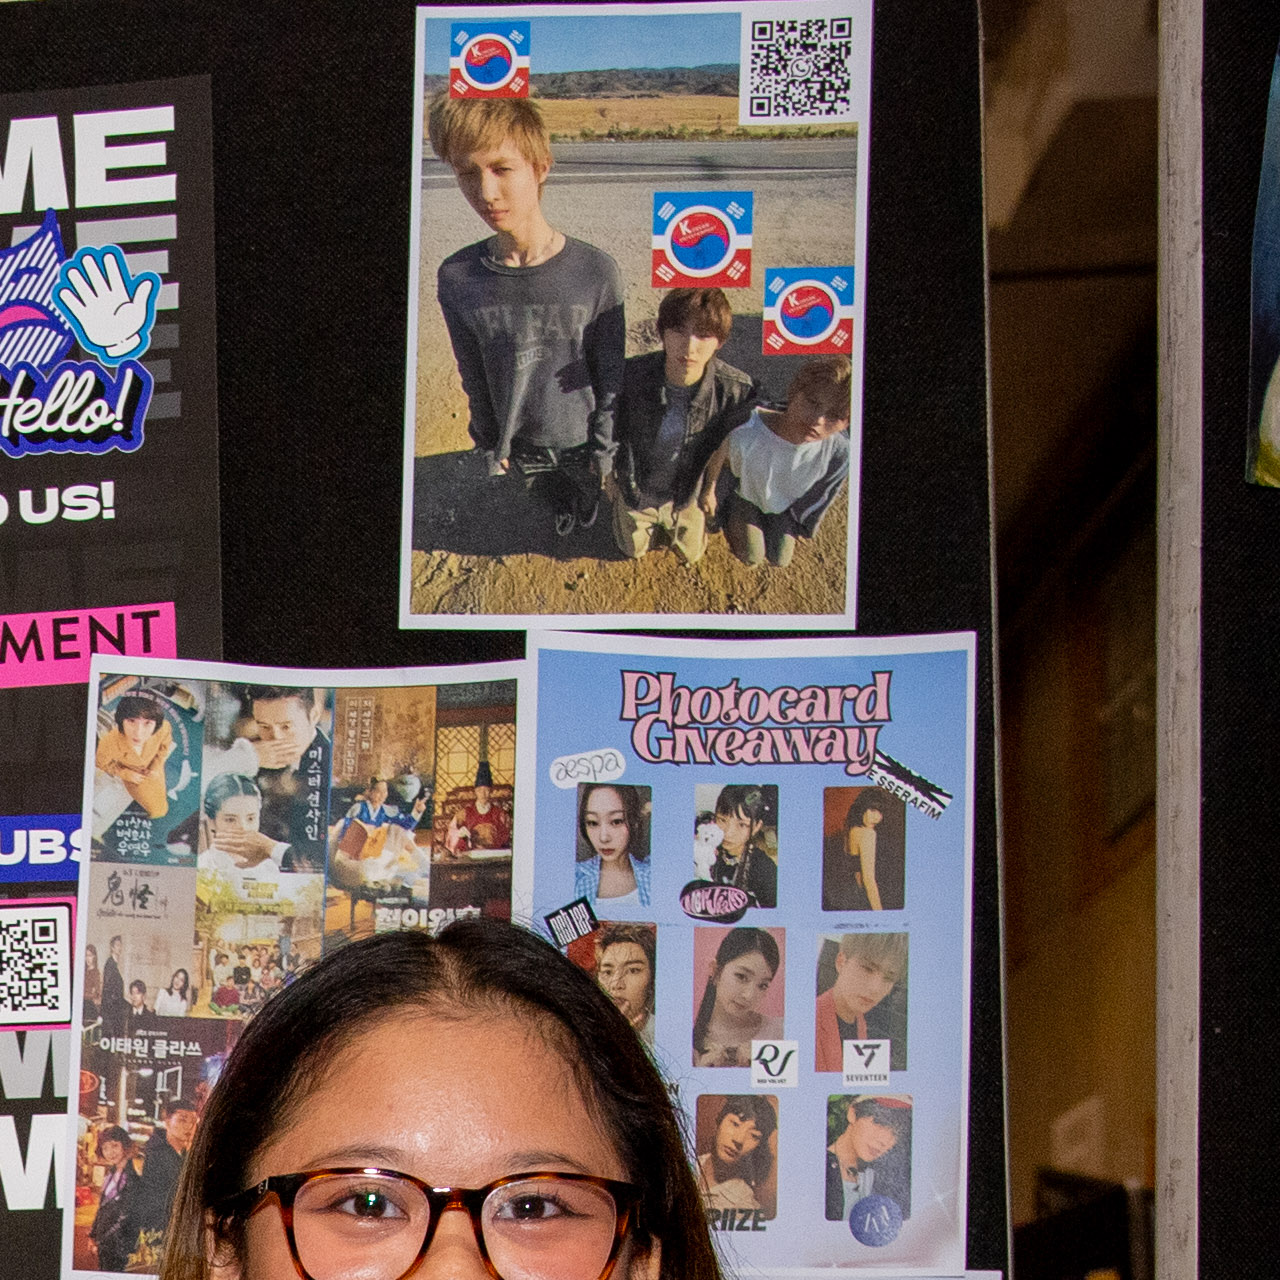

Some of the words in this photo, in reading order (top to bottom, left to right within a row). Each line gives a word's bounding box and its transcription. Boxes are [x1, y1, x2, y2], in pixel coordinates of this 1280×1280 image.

[18, 481, 116, 526] US!
[621, 670, 893, 725] Photocard
[556, 752, 620, 782] aespa
[876, 774, 942, 821] SSERAFIM
[100, 1036, 149, 1058] 이태원
[152, 1039, 203, 1059] 클라쓰
[708, 1208, 767, 1232] RIIZE
